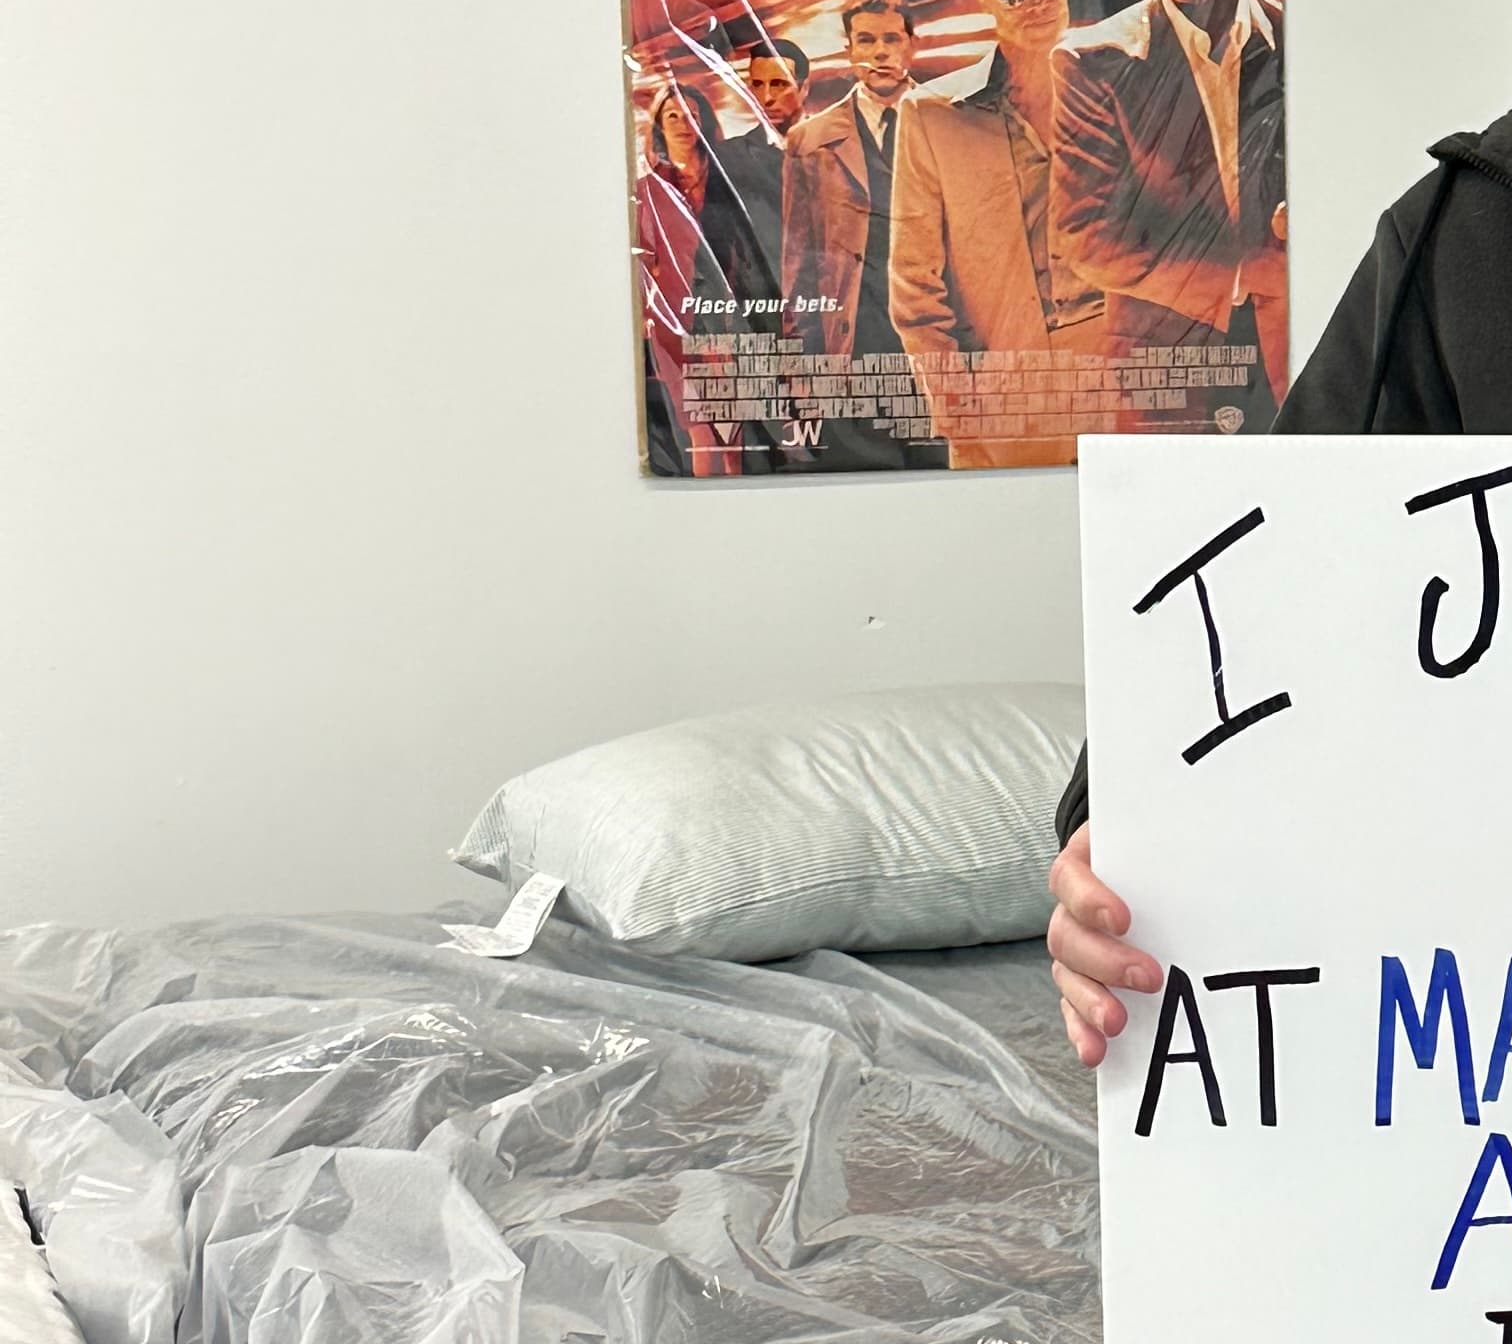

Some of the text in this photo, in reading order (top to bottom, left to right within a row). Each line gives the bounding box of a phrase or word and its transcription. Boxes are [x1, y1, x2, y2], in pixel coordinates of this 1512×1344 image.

[681, 294, 844, 318] Place your bets.
[1133, 507, 1292, 765] I
[1134, 962, 1321, 1137] AT
